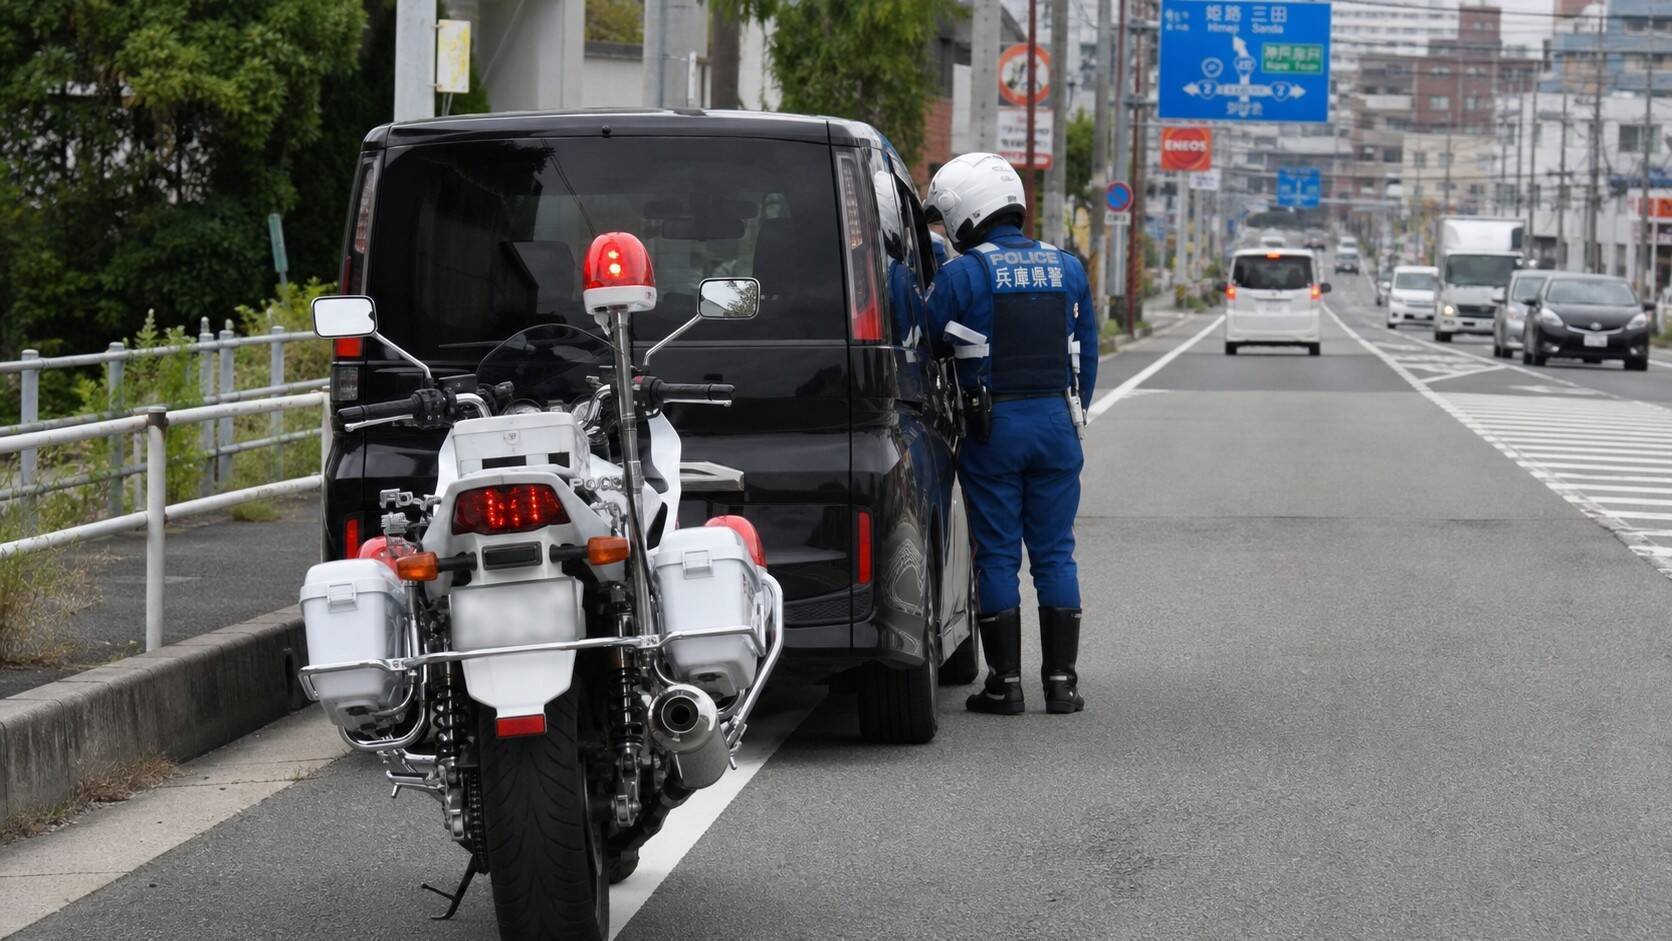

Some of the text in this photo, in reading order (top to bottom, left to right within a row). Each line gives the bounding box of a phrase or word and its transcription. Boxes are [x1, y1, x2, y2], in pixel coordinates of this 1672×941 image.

[1206, 4, 1241, 21] 姫路
[1251, 6, 1287, 22] 三田
[1164, 139, 1207, 152] ENEOS
[990, 251, 1059, 265] POLICE
[996, 266, 1063, 288] 兵庫県警
